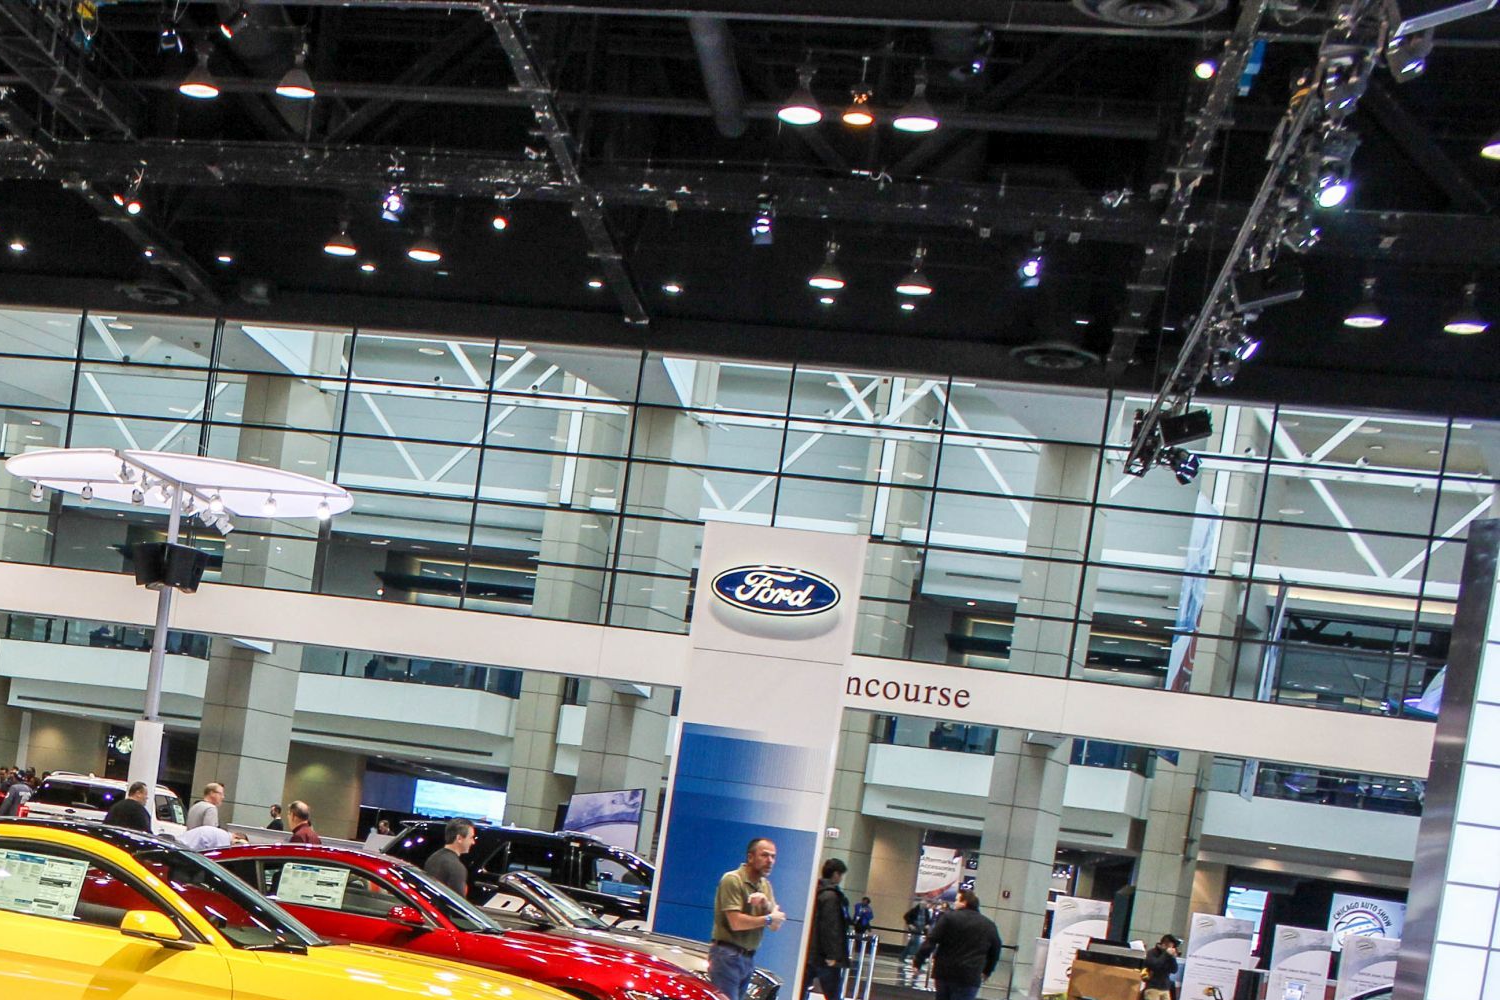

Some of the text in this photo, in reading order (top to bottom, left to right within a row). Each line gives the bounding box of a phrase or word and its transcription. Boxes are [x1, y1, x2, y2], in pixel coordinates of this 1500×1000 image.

[735, 571, 812, 607] Ford
[1333, 901, 1393, 927] CHICAGO AUTO SHOW
